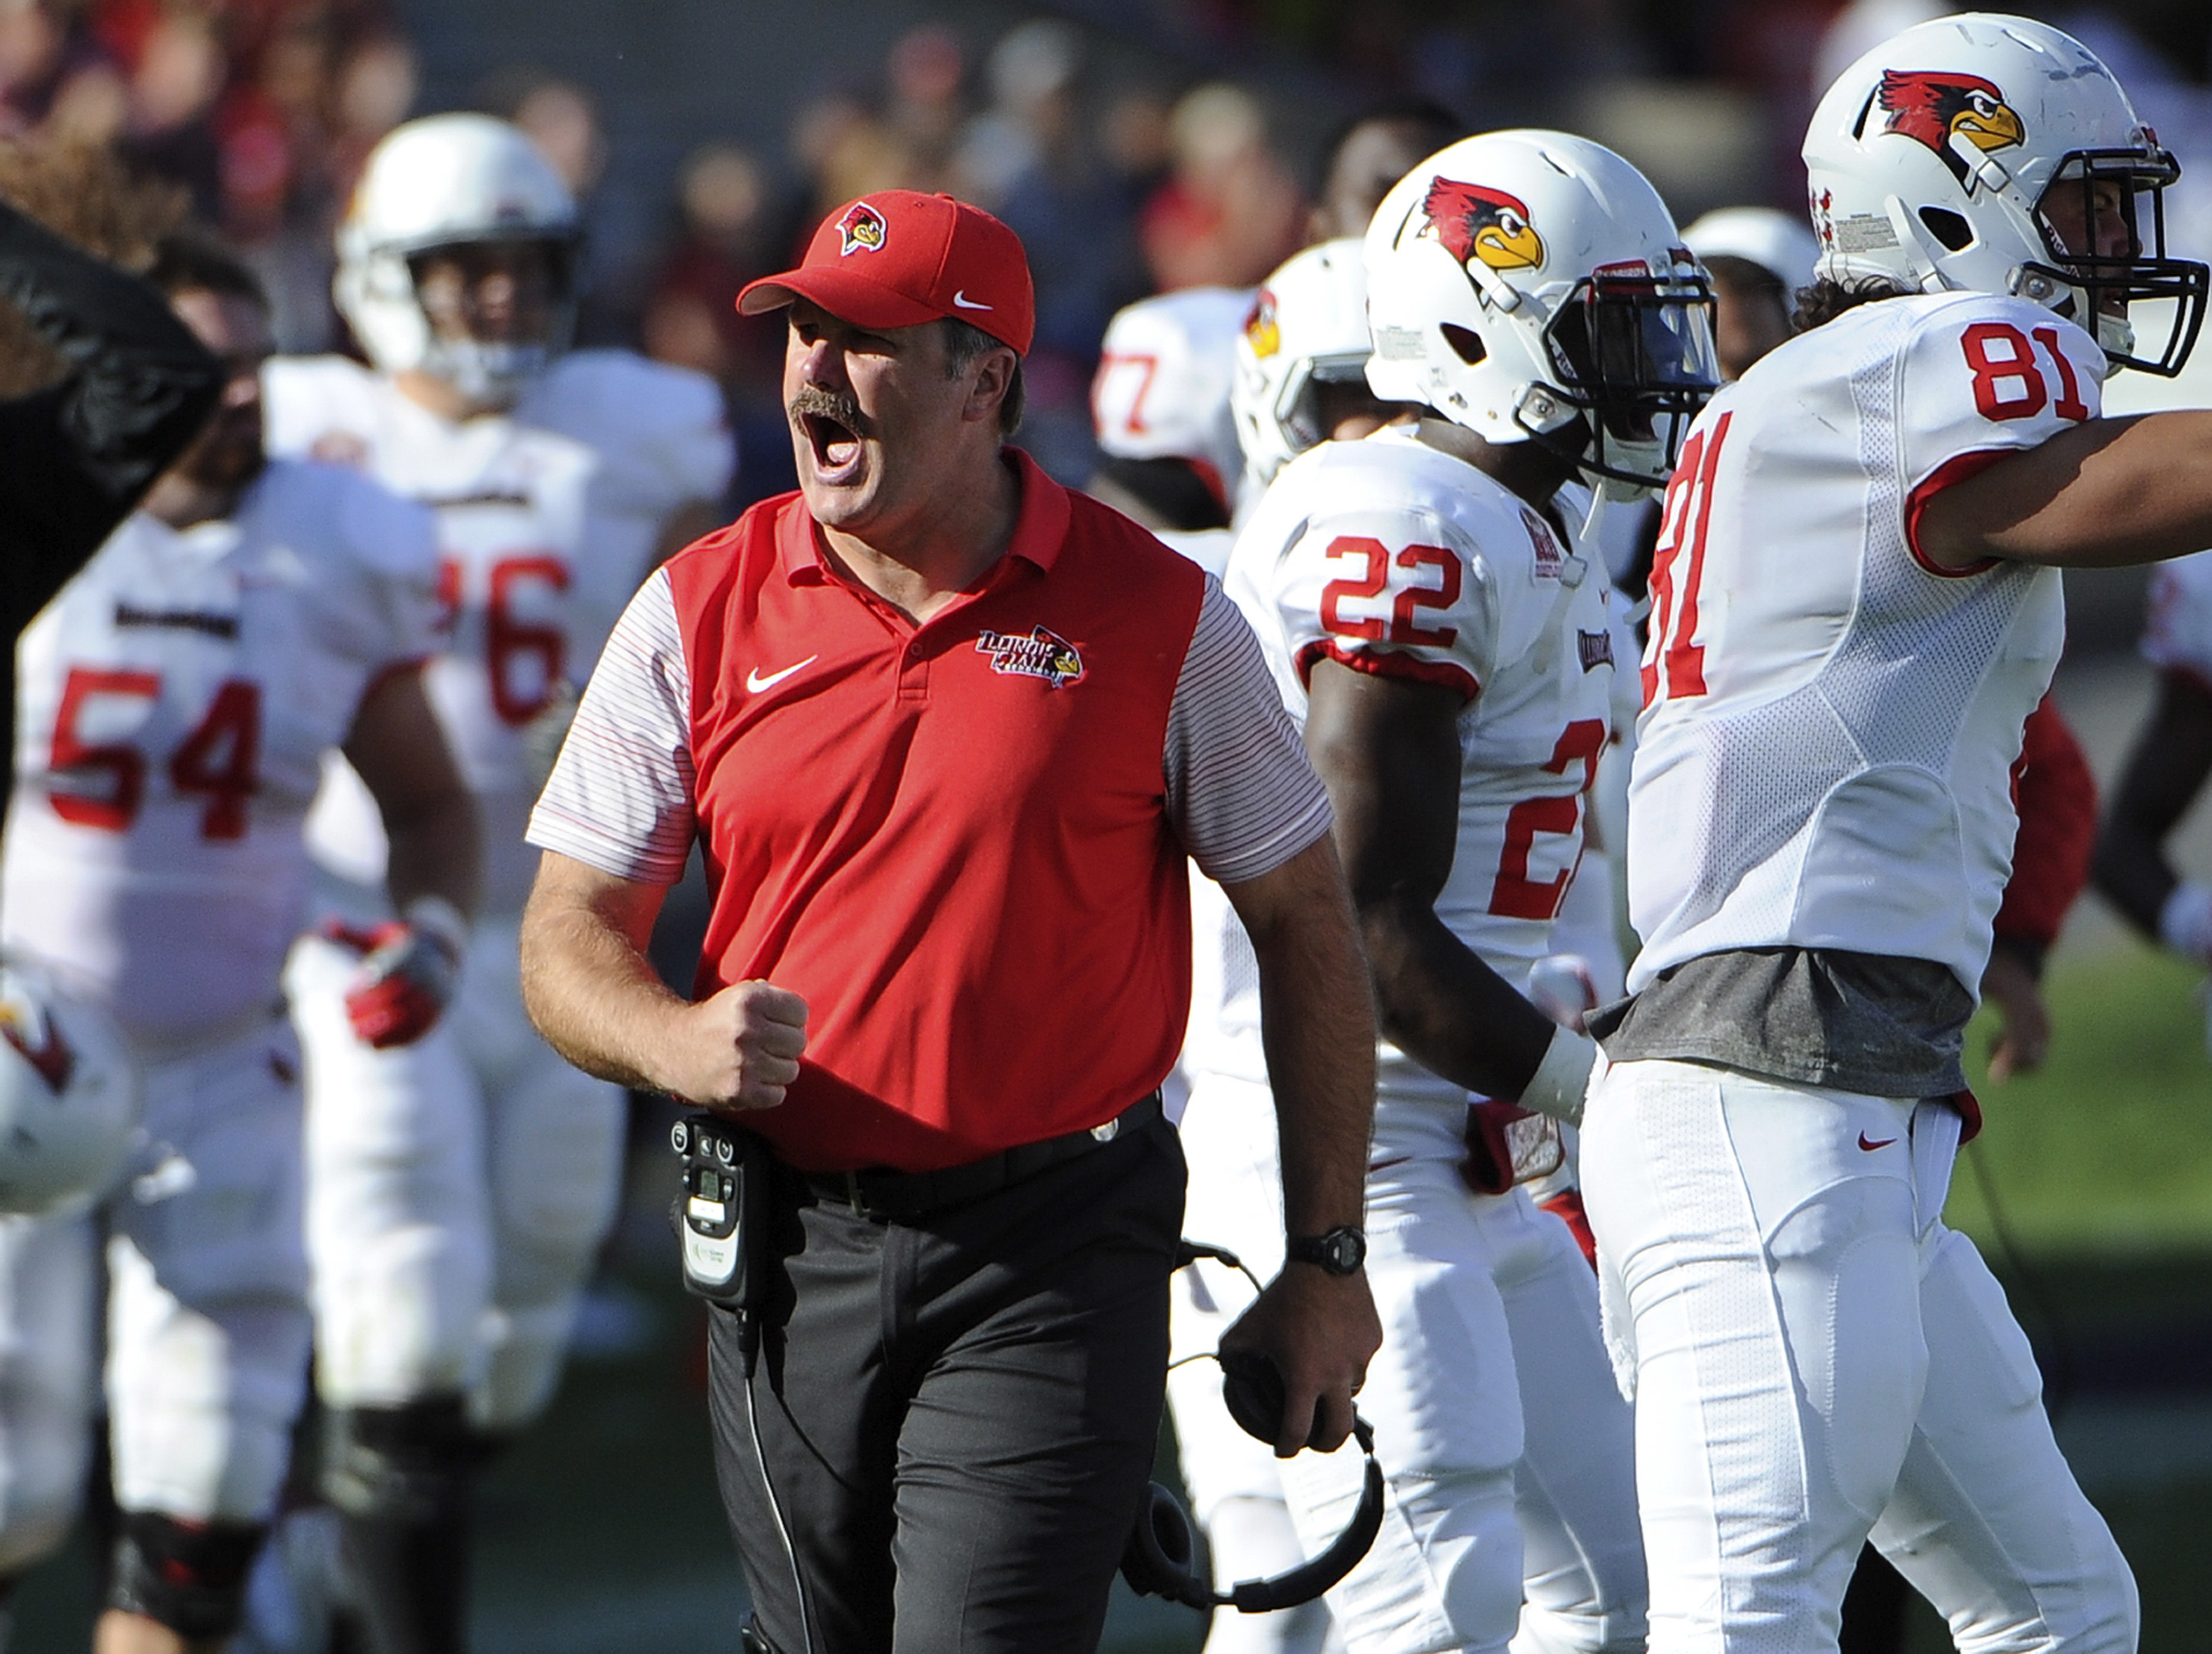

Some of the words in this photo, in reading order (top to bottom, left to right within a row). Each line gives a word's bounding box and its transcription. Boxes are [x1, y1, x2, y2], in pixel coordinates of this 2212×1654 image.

[1090, 351, 1157, 436] 7
[1960, 322, 2088, 422] 81
[1320, 535, 1462, 647] 22
[49, 668, 262, 841] 54
[1488, 718, 1606, 919] 2
